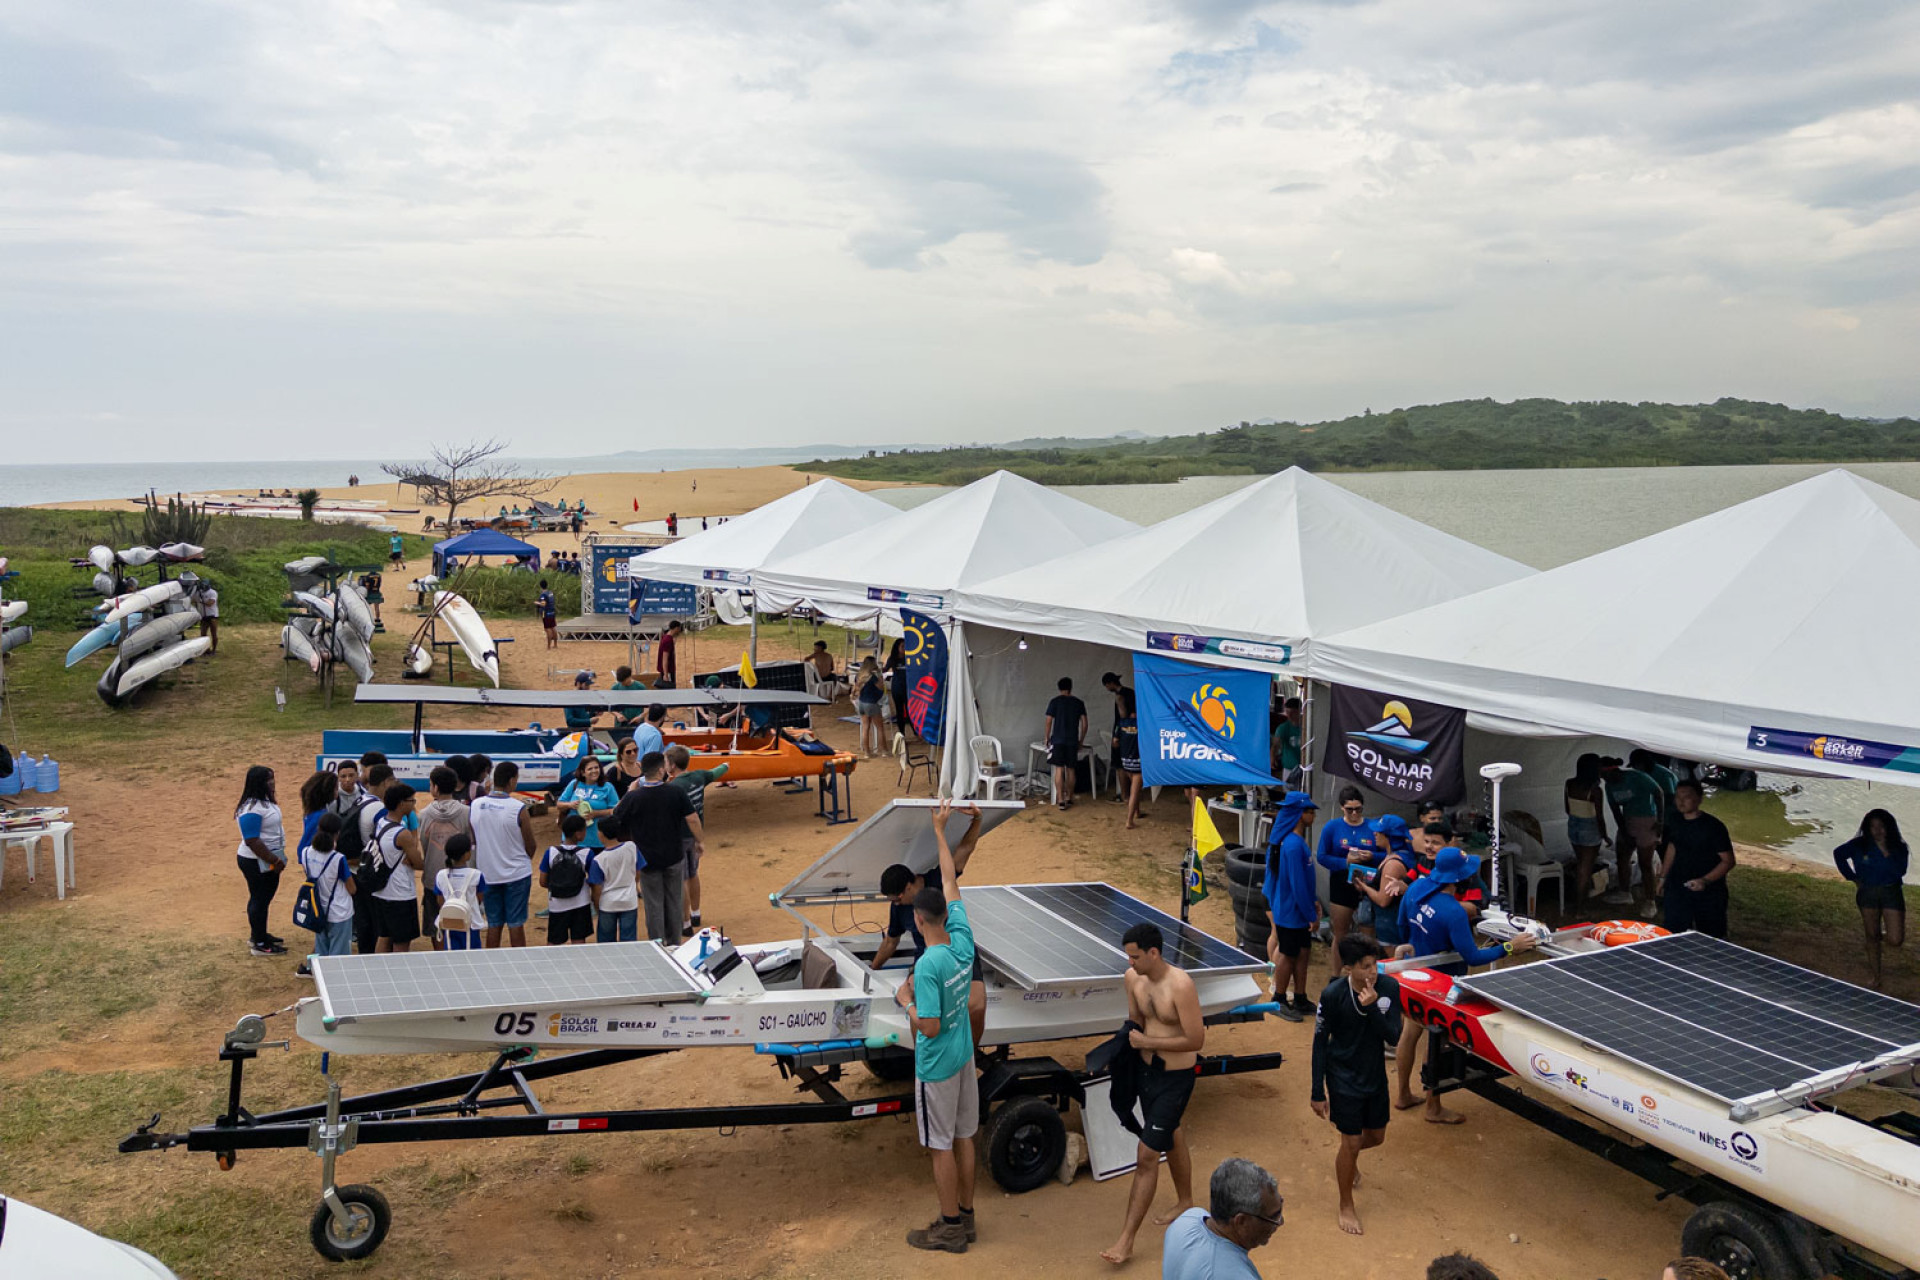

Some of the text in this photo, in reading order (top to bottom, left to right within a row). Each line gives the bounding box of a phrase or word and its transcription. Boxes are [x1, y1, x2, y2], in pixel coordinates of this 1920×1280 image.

[1160, 729, 1187, 738] Equipe
[1755, 733, 1768, 747] 3
[1826, 741, 1864, 751] SOLAR
[1824, 746, 1863, 757] BRASIL
[1347, 742, 1433, 781] SOLMAR
[1352, 762, 1424, 792] CELERIS
[494, 1012, 537, 1035] 05
[561, 1017, 598, 1025] SOLAR
[787, 1009, 827, 1029] GAÚCHO
[560, 1025, 599, 1033] BRASIL
